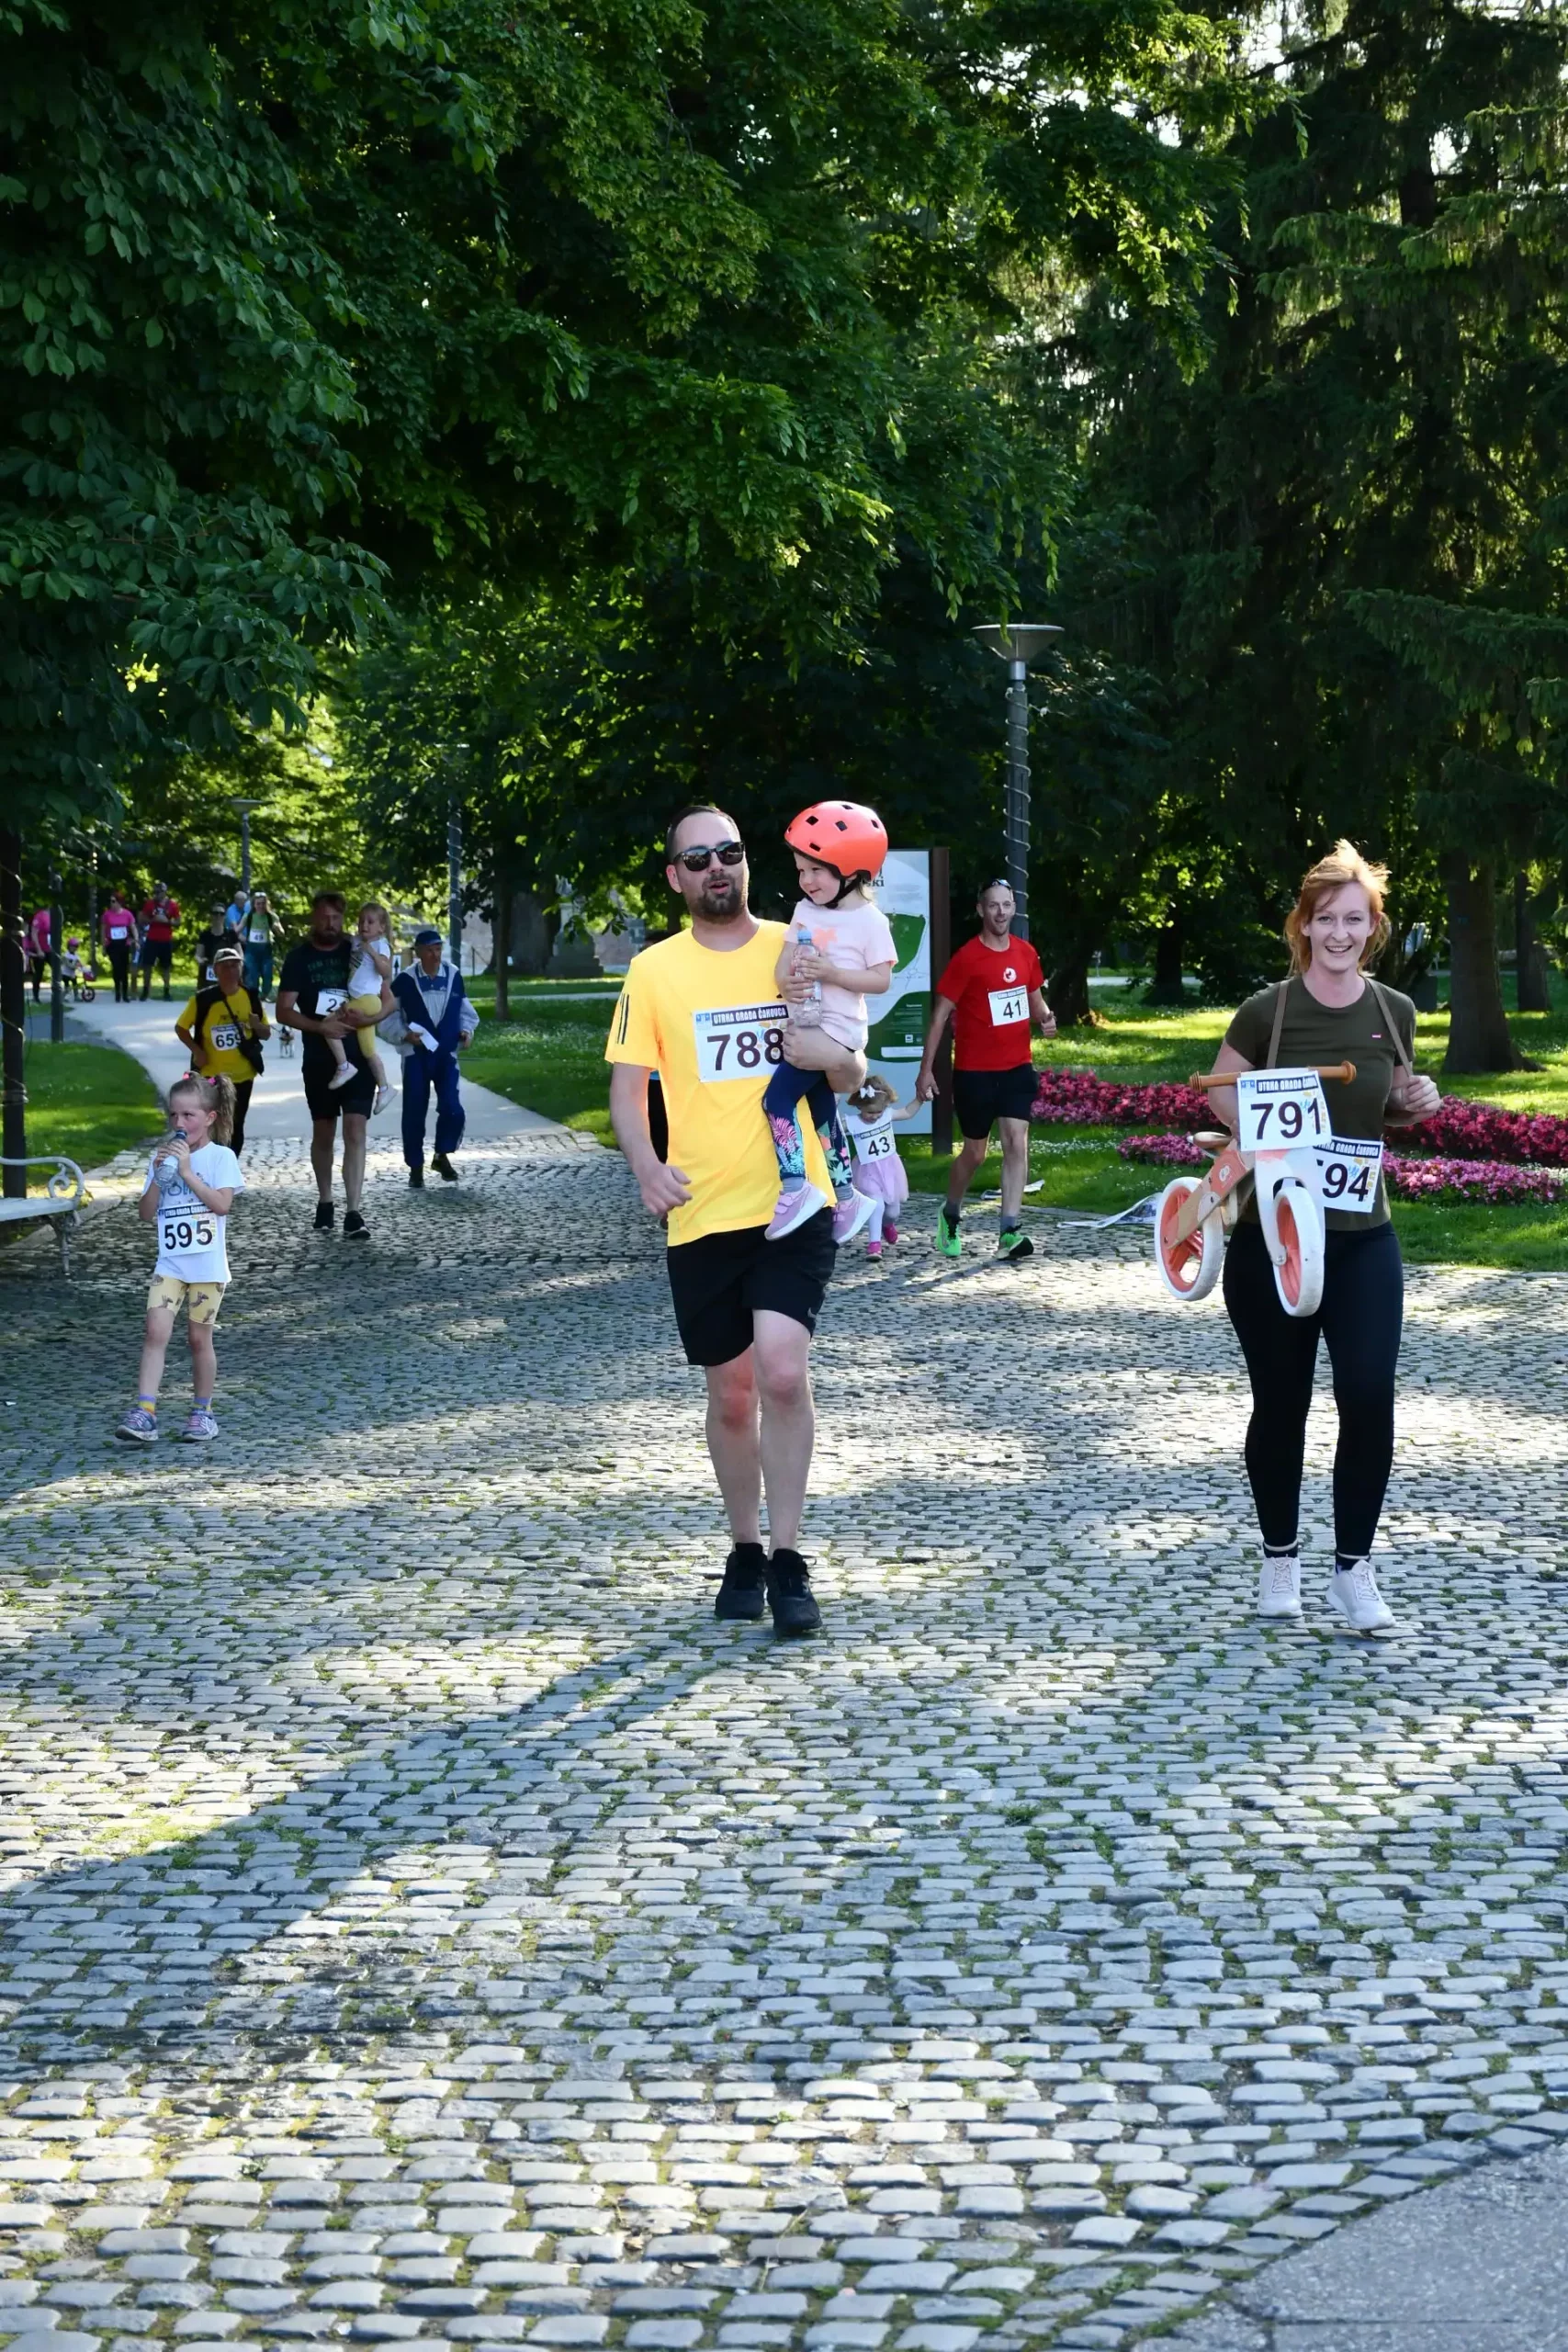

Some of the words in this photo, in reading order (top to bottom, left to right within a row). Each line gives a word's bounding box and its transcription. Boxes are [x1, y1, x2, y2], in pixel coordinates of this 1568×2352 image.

[1003, 1000, 1021, 1018] 41
[706, 1028, 784, 1071] 788
[1250, 1097, 1321, 1140] 791
[868, 1136, 890, 1156] 43
[1316, 1159, 1370, 1202] 94
[164, 1220, 213, 1250] 595
